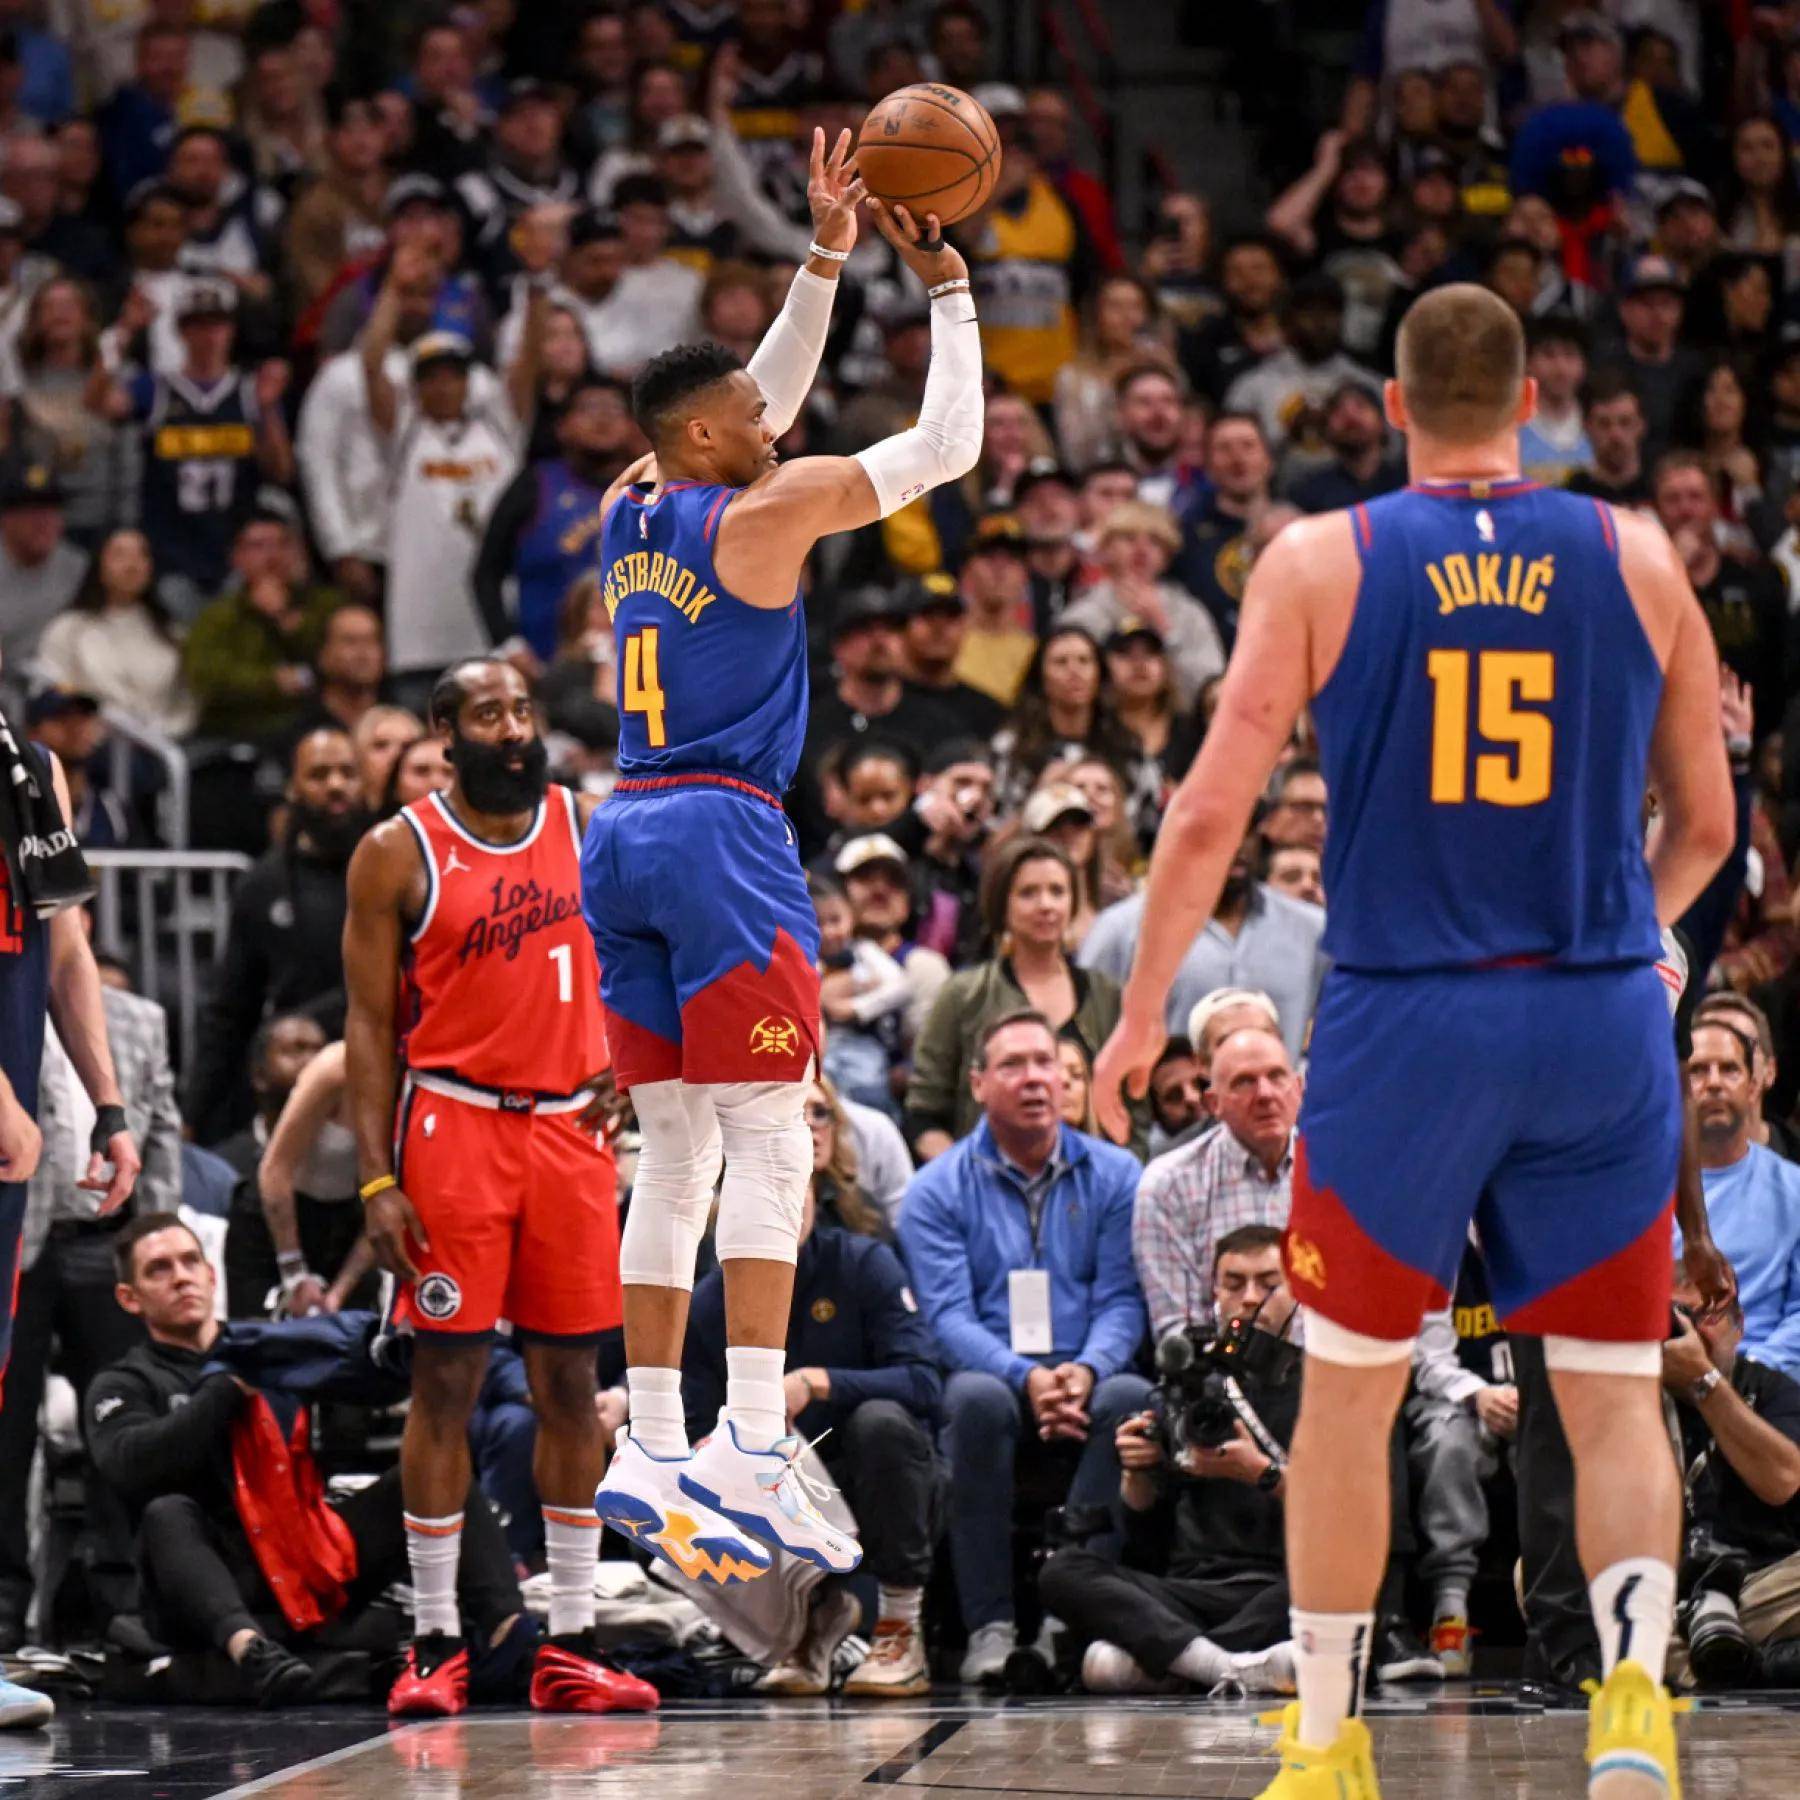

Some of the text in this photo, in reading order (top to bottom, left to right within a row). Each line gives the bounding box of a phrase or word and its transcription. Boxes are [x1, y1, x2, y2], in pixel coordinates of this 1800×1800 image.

[1425, 553, 1555, 616] JOKIĆ
[622, 625, 667, 748] 4
[1426, 648, 1555, 808] 15
[458, 888, 583, 968] Angeles
[490, 876, 543, 918] Los
[547, 943, 573, 1004] 1
